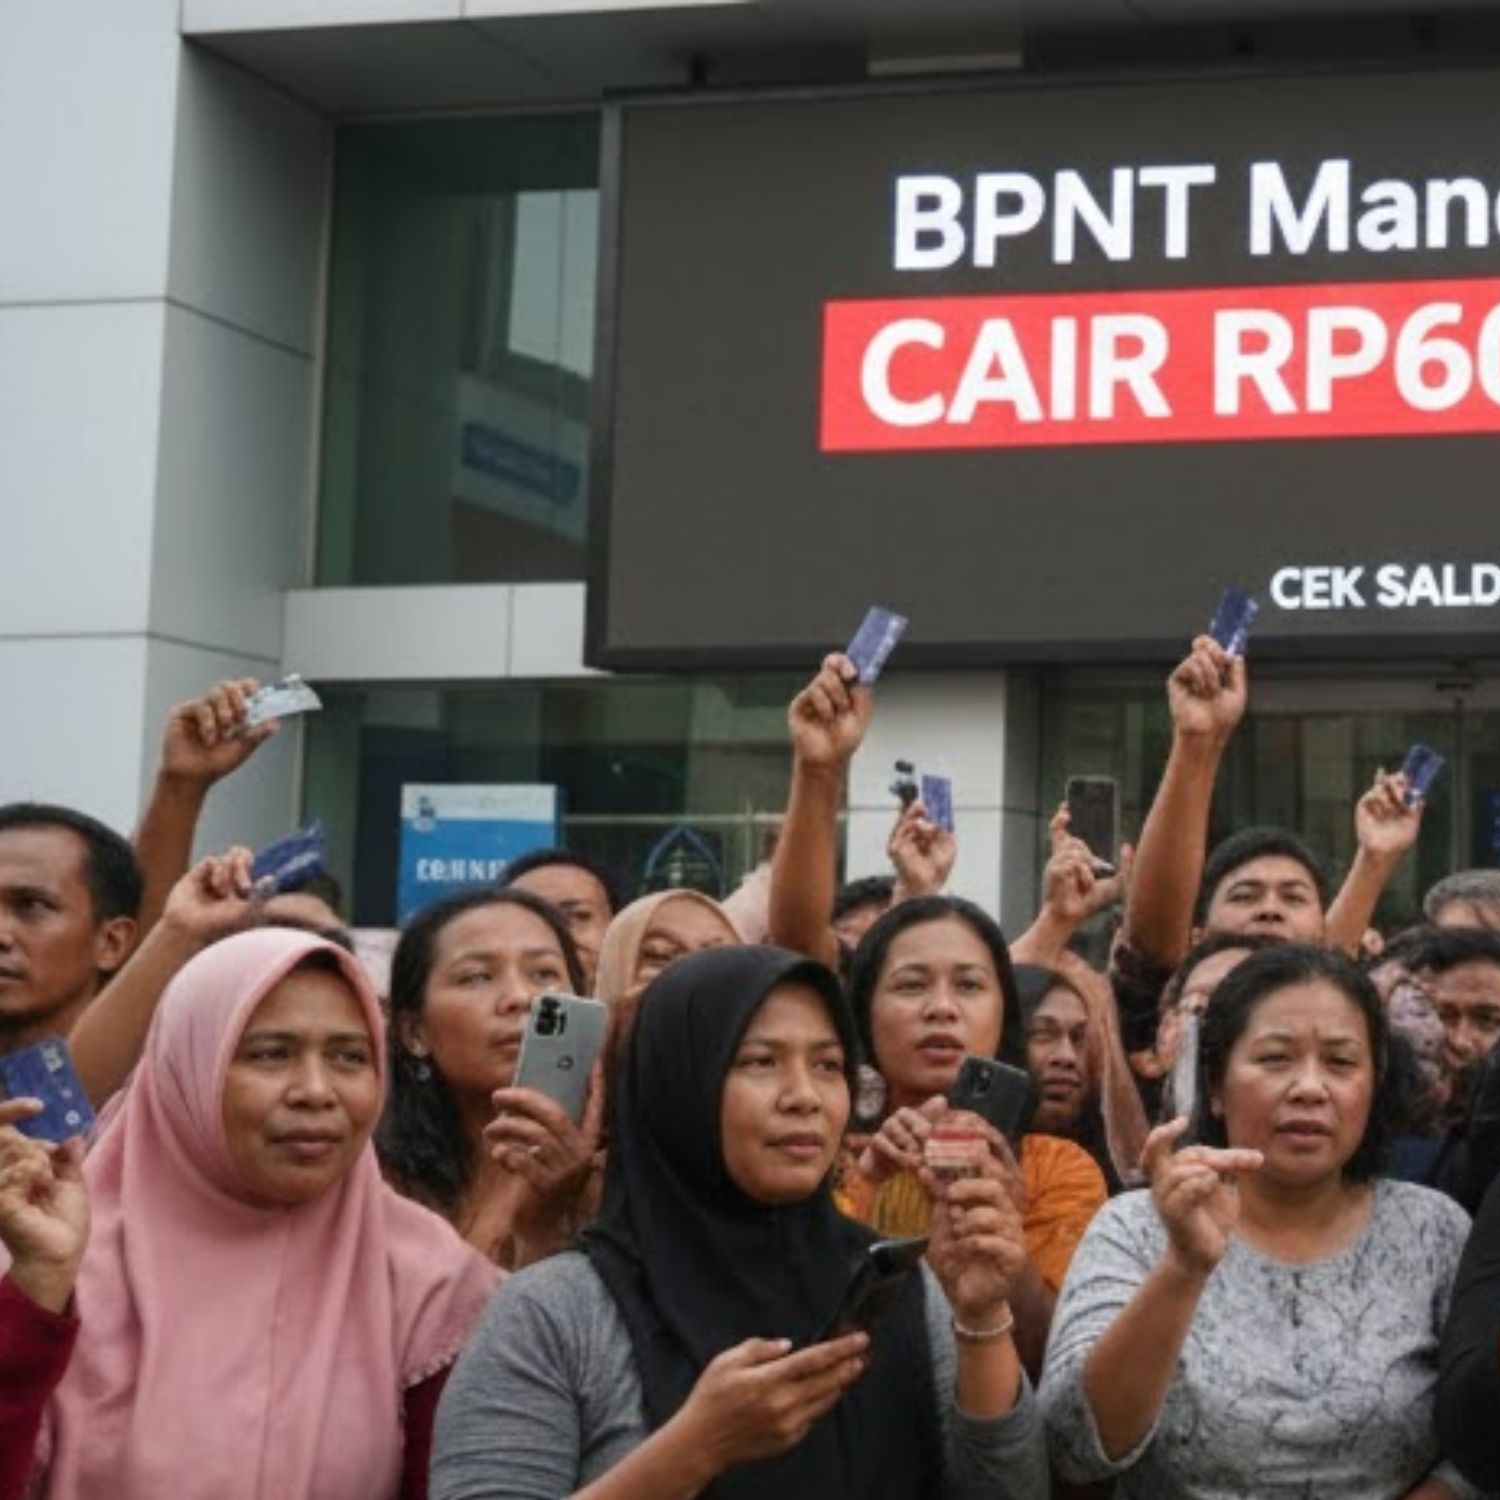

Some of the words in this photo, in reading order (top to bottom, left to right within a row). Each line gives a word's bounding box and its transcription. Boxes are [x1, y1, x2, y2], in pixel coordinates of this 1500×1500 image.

[893, 165, 1216, 270] BPNT
[860, 309, 1172, 428] CAIR
[1269, 565, 1367, 610] CEK
